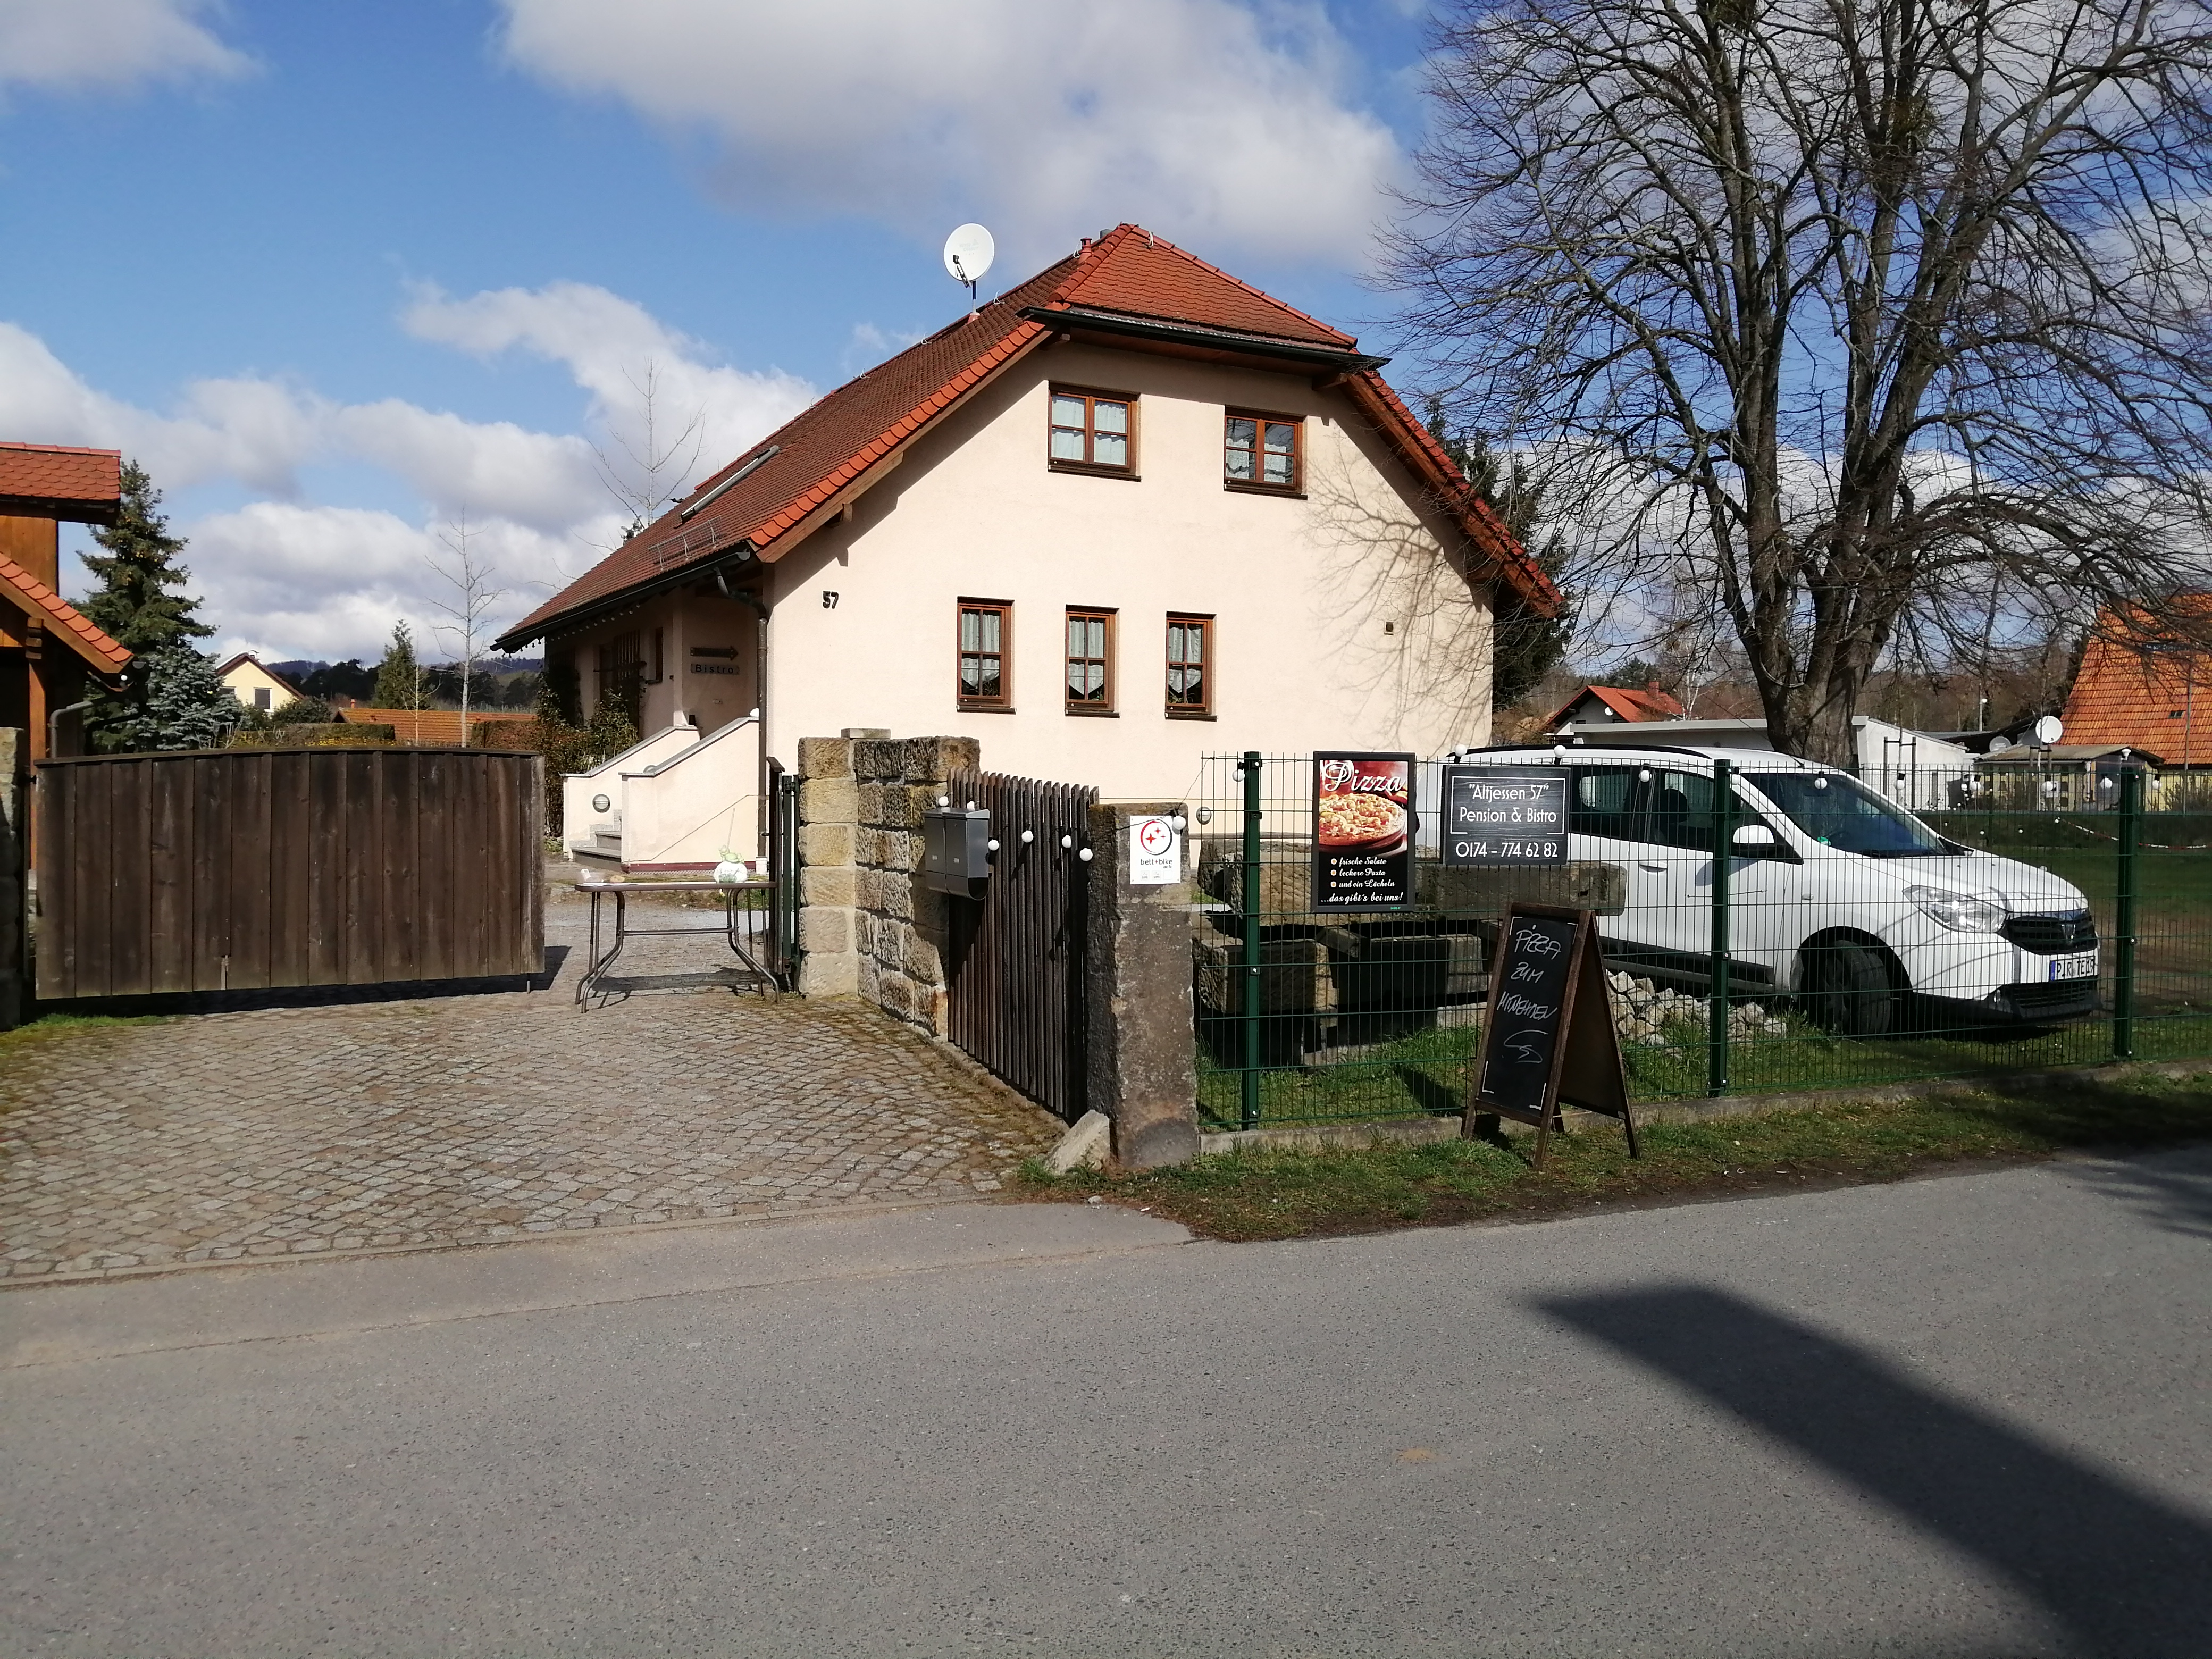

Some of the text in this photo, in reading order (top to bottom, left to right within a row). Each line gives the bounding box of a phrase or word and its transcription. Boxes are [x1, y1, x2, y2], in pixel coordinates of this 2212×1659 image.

[823, 591, 839, 609] 57
[696, 664, 734, 674] Bistro
[1324, 762, 1405, 791] Pizza
[1460, 806, 1557, 823] Pension & Bistro
[1456, 842, 1488, 857] 0174
[1501, 842, 1522, 857] 774
[1526, 842, 1539, 857] 62
[1544, 842, 1558, 857] 82
[1339, 857, 1363, 867] frische
[1365, 868, 1386, 876] Pasta
[1364, 879, 1396, 887] Lächeln
[1371, 892, 1384, 901] bei
[1384, 892, 1404, 901] uns!
[1510, 961, 1544, 984] ZUM
